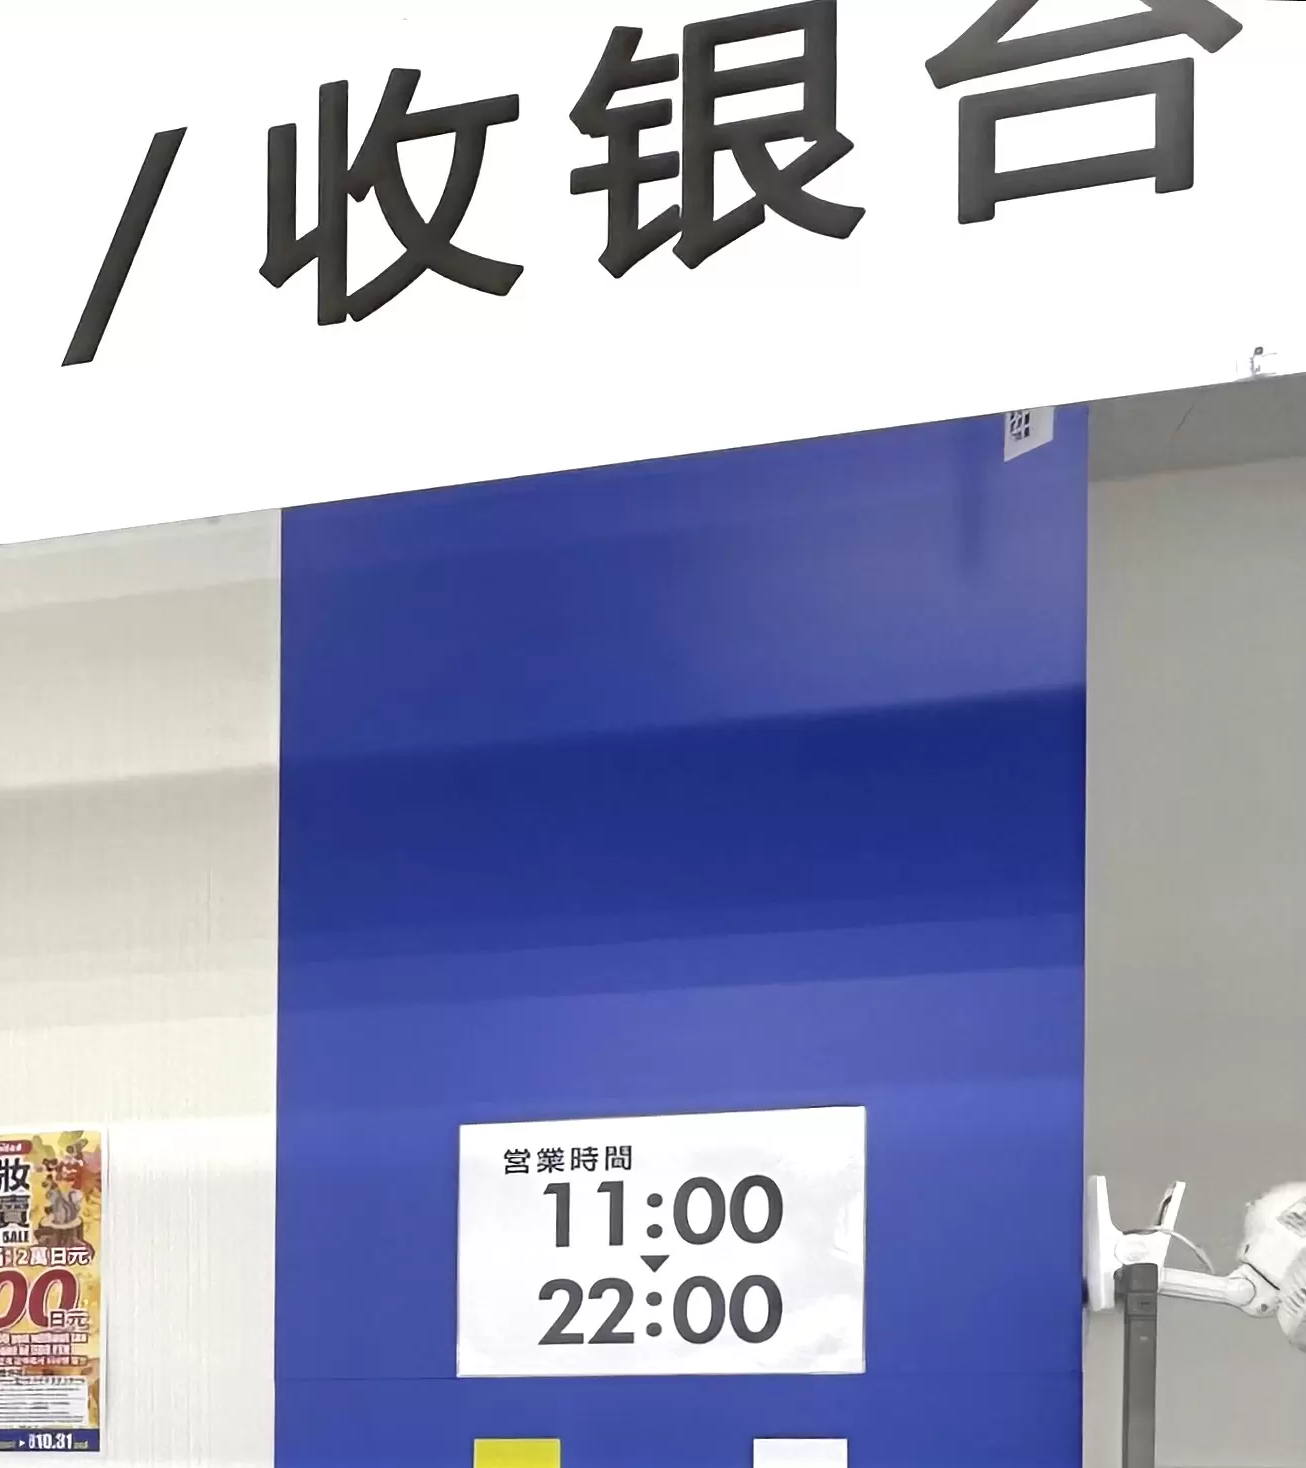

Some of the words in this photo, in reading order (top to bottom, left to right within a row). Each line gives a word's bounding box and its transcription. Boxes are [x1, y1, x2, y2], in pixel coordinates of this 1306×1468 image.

[259, 0, 1245, 329] 收银台
[503, 1145, 633, 1175] 営業時間
[543, 1175, 783, 1247] 11:00
[48, 1310, 89, 1328] 日元
[538, 1274, 783, 1344] 22:00
